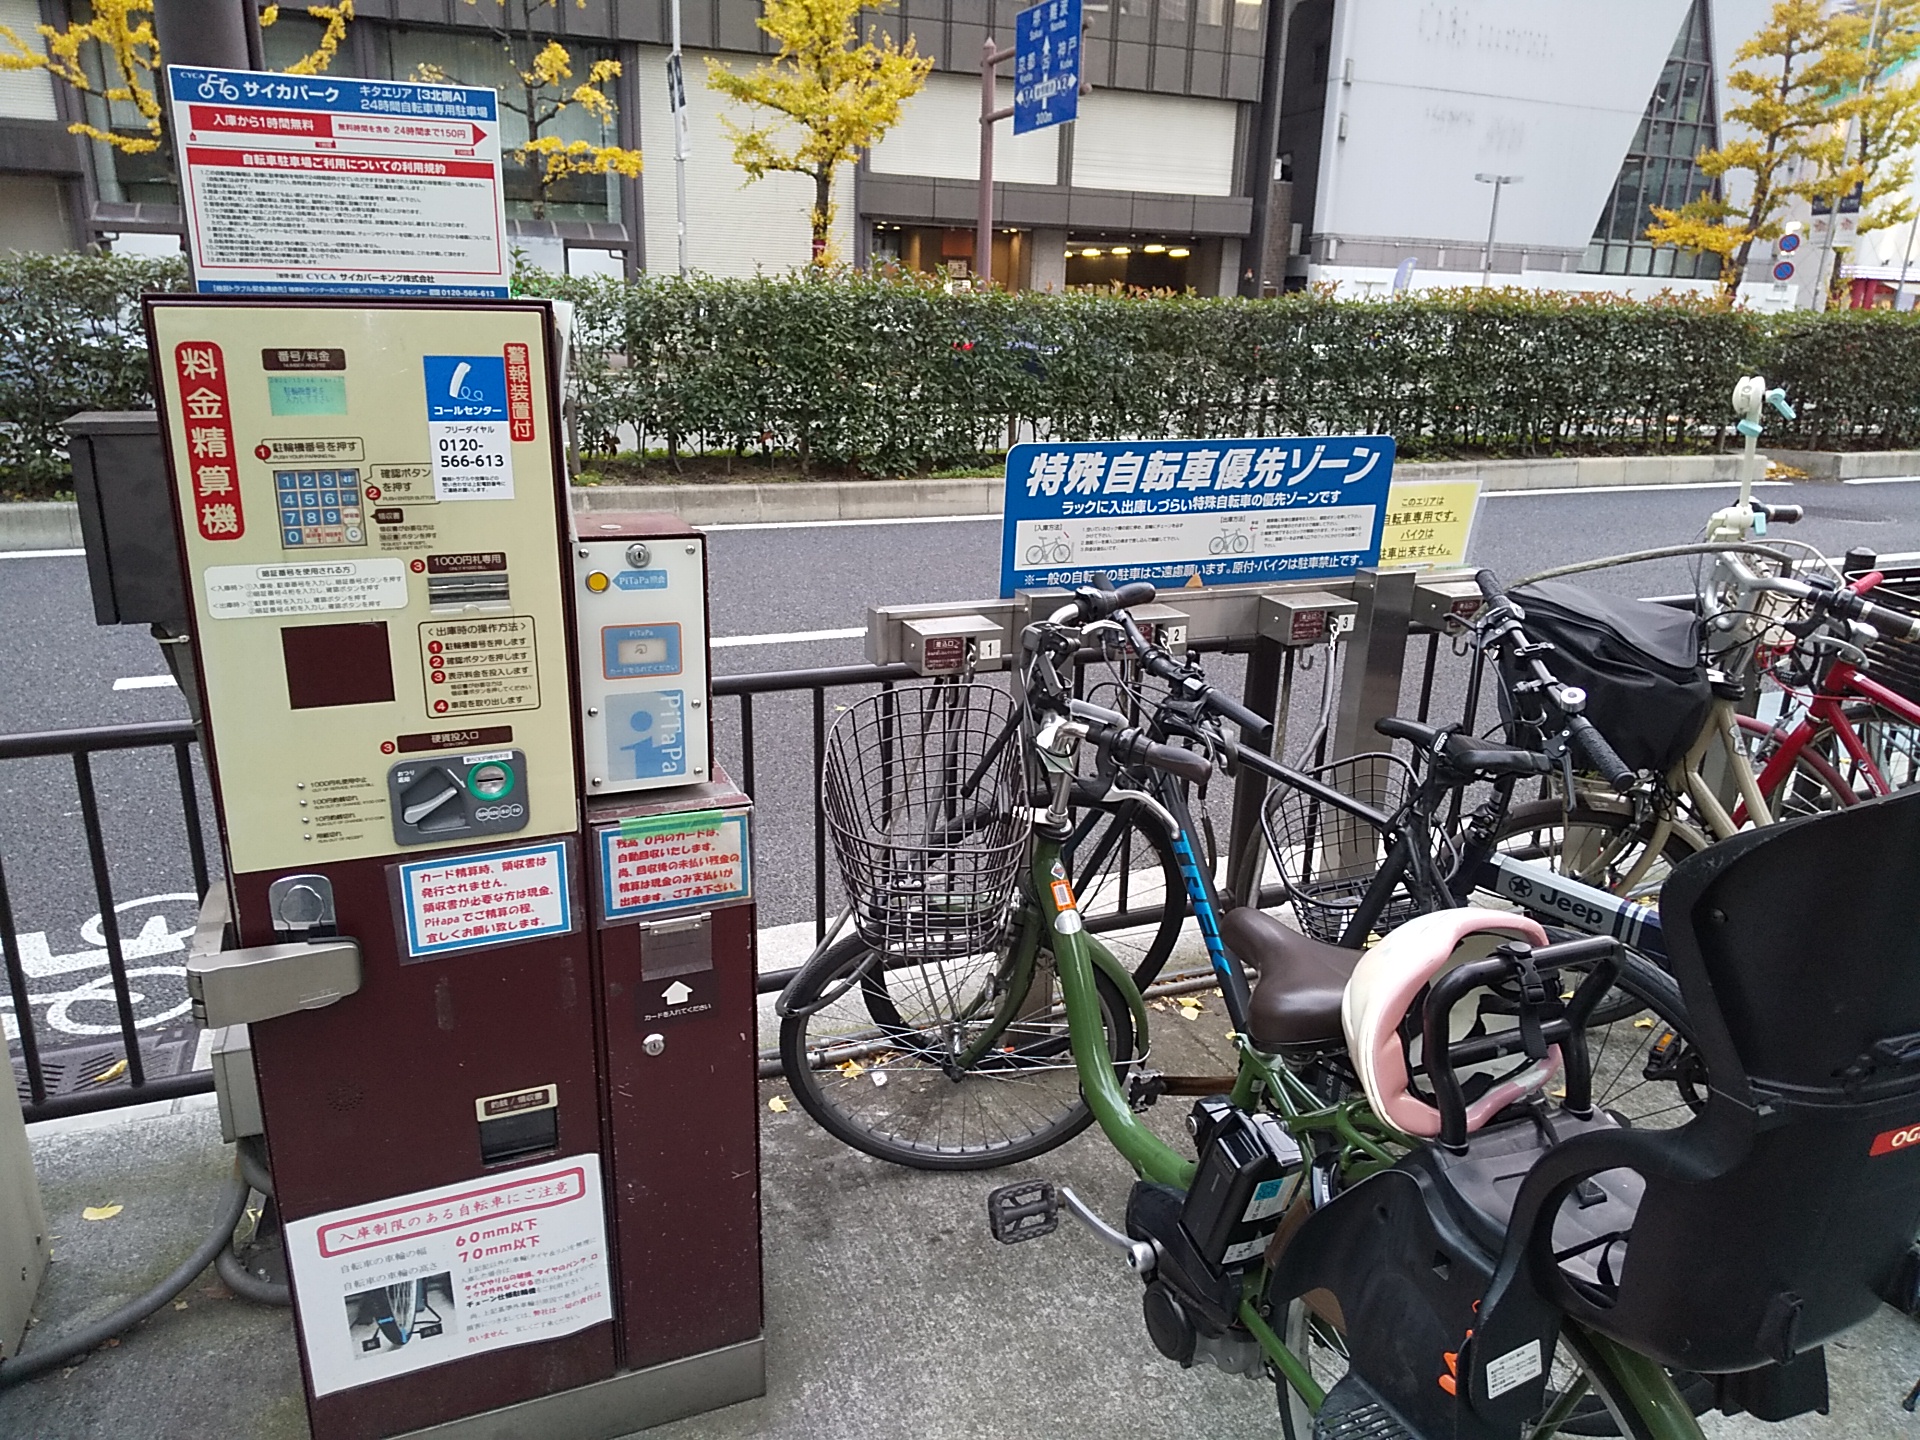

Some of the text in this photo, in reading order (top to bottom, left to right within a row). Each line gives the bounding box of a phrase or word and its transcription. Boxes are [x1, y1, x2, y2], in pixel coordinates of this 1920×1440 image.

[243, 80, 338, 102] サイカパーク
[360, 85, 412, 99] キタエリア
[360, 99, 488, 118] 24時間自転車専用駐車場
[213, 113, 314, 131] 入庫から1時間無料
[338, 123, 465, 138] 無料時間を含め 24時間まで150円
[243, 152, 446, 174] 自転車駐車場ご利用についての利用規約
[306, 273, 435, 284] CYCA サイカパーキング株式会社
[389, 288, 428, 296] コールセンター
[441, 289, 495, 298] 0120-566-613
[277, 350, 331, 362] 番号/料金
[507, 346, 532, 439] 警報装置付
[433, 406, 502, 416] コールセンター
[444, 426, 495, 434] フリーダイヤル
[181, 347, 239, 535] 料金精算機
[272, 441, 357, 453] 駐輪機番号を押す
[439, 438, 484, 452] 0120-
[441, 454, 504, 468] 566-613
[380, 468, 432, 479] 確認ボタン
[1026, 445, 1382, 497] 特殊自転車優先ゾーン
[283, 476, 291, 487] 1
[302, 475, 313, 487] 2
[322, 474, 332, 486] 3
[382, 483, 412, 493] を押す
[284, 493, 334, 505] 4 5 6
[1061, 490, 1342, 516] ラックに入出庫しづらい特殊自転車の優先ゾーンです
[1401, 496, 1445, 507] このエリアは
[287, 513, 296, 524] 7
[306, 512, 317, 523] 8
[326, 511, 336, 523] 9
[288, 532, 299, 543] 0
[350, 531, 358, 539] C
[1400, 529, 1435, 540] バイクは
[434, 554, 502, 566] 1000円札専用
[261, 566, 351, 578] 暗証番号を使用される方
[1024, 554, 1365, 586] ※一般の自転の駐車はご遠慮願います。原付・バイクは駐車禁止です。
[629, 629, 654, 638] PiTaPa
[1173, 629, 1180, 642] 2
[445, 637, 527, 650] 駐輪機番号を押します
[987, 642, 993, 657] 1
[446, 652, 528, 665] 確認ボタンを押します
[448, 666, 529, 680] 表示料金を投入します
[450, 696, 523, 709] 車両を取り出します
[431, 731, 479, 743] 硬貨投入口
[618, 842, 716, 864] 自動回収いたします。
[618, 853, 740, 879] 尚、回収後の未払い残金の
[421, 878, 508, 898] 発行されません。
[618, 868, 734, 893] 精算は現金のみ支払いが
[423, 885, 555, 914] 領収書が必要な方は現金、
[620, 882, 737, 907] 出来ます。 ご了承下さい。
[1539, 889, 1604, 925] Jeep
[424, 903, 535, 928] Pitapa でご精算の程、
[426, 917, 546, 944] 宜しくお願い致します。
[644, 1003, 712, 1022] カードを入れてください
[1890, 1126, 1920, 1147] OG
[338, 1180, 568, 1243] 入庫制限のある自転車にご注意
[455, 1217, 538, 1248] 60mm以下
[458, 1234, 541, 1264] 70mm以下
[340, 1246, 428, 1274] 自転車の車輪の幅
[343, 1261, 439, 1291] 自転車の車輪の高さ
